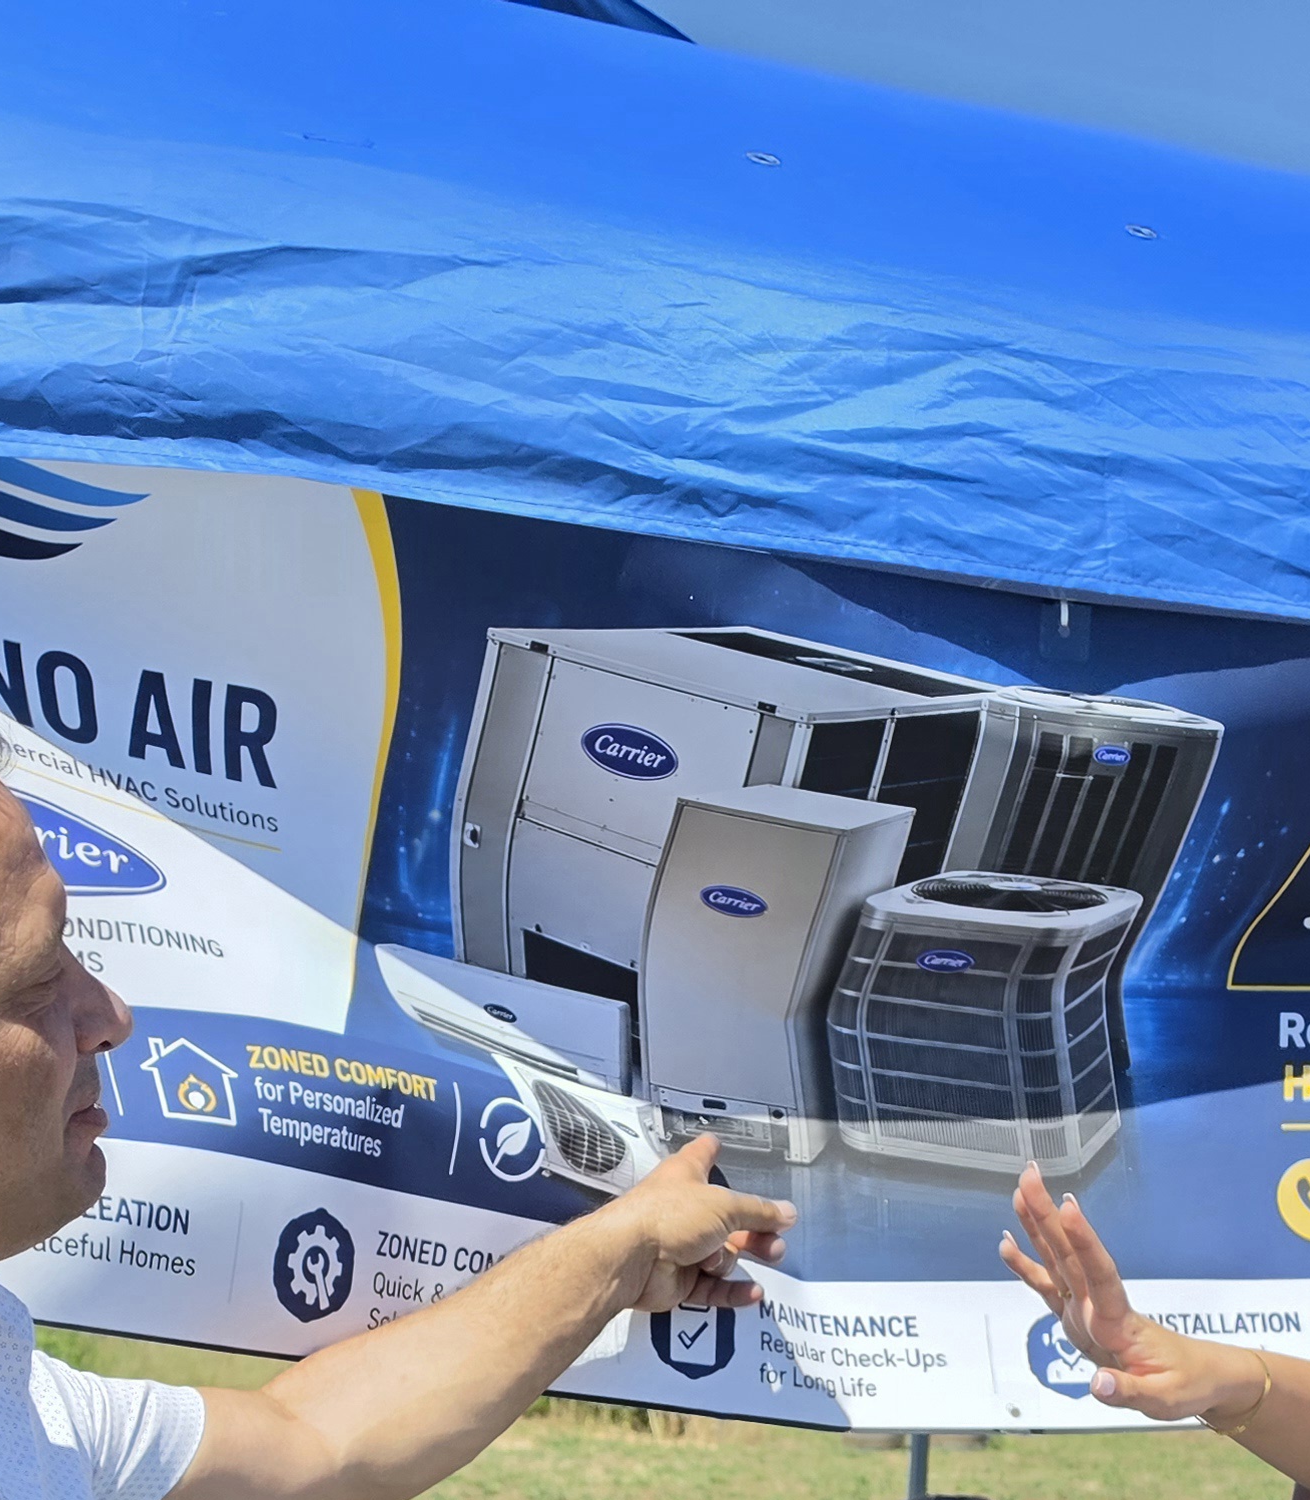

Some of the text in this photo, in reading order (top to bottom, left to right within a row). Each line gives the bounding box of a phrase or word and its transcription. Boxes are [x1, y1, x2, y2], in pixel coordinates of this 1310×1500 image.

[128, 670, 278, 789] AIR
[594, 734, 667, 768] Carrier
[13, 742, 279, 833] ercial HVAC Solutions
[34, 826, 130, 874] rier
[709, 890, 761, 911] Carrier
[62, 916, 225, 958] ONDITIONING
[246, 1044, 437, 1101] ZONED COMFORT
[254, 1077, 404, 1129] for Personalized
[258, 1108, 382, 1157] Temperatures
[119, 1239, 196, 1276] Homes
[376, 1230, 447, 1267] ZONED
[373, 1271, 445, 1304] Quick &
[759, 1300, 919, 1337] MAINTENANCE
[760, 1331, 947, 1373] Regular Check-Ups
[759, 1362, 878, 1398] for Long Life
